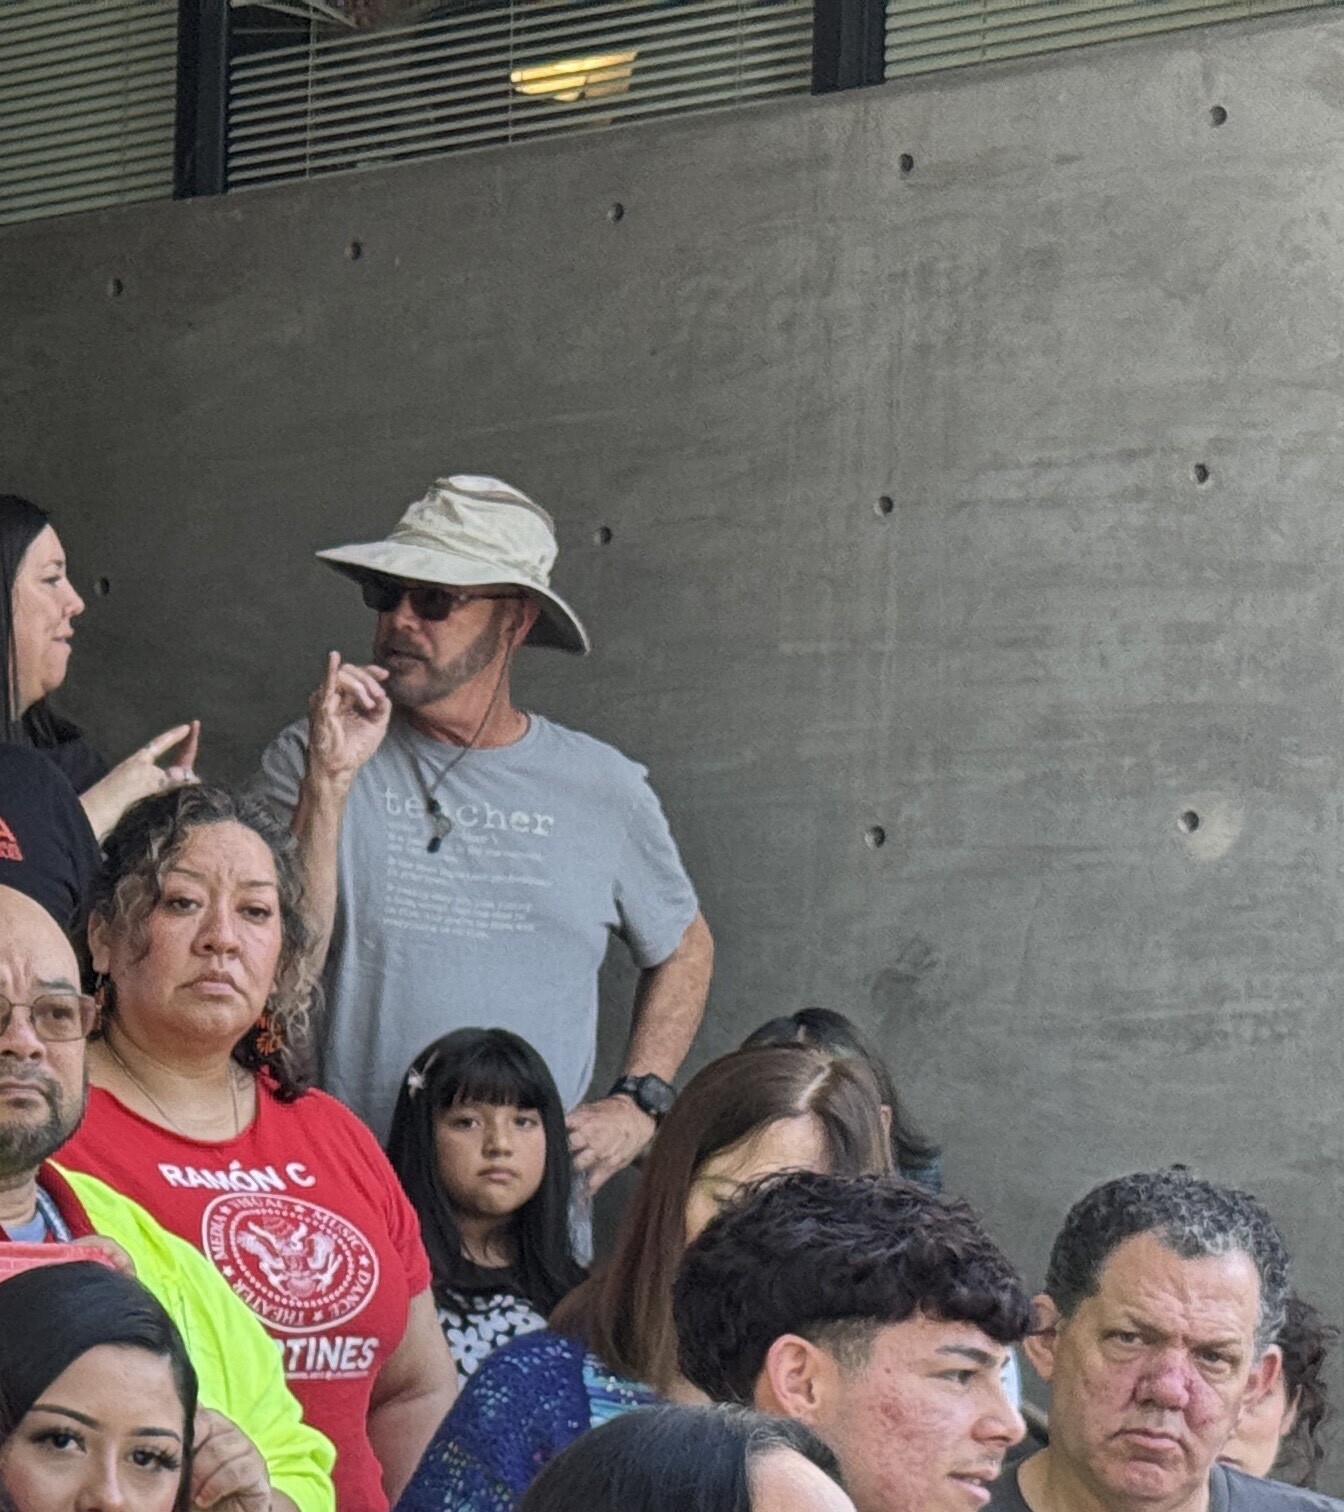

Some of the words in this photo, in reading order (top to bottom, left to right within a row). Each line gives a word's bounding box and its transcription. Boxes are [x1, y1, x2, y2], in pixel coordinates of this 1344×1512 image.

[385, 787, 554, 837] techer
[158, 1159, 287, 1191] RAMÓN
[210, 1214, 229, 1261] MEDIA
[314, 1209, 364, 1252] MUSIC
[328, 1271, 372, 1318] DANCE
